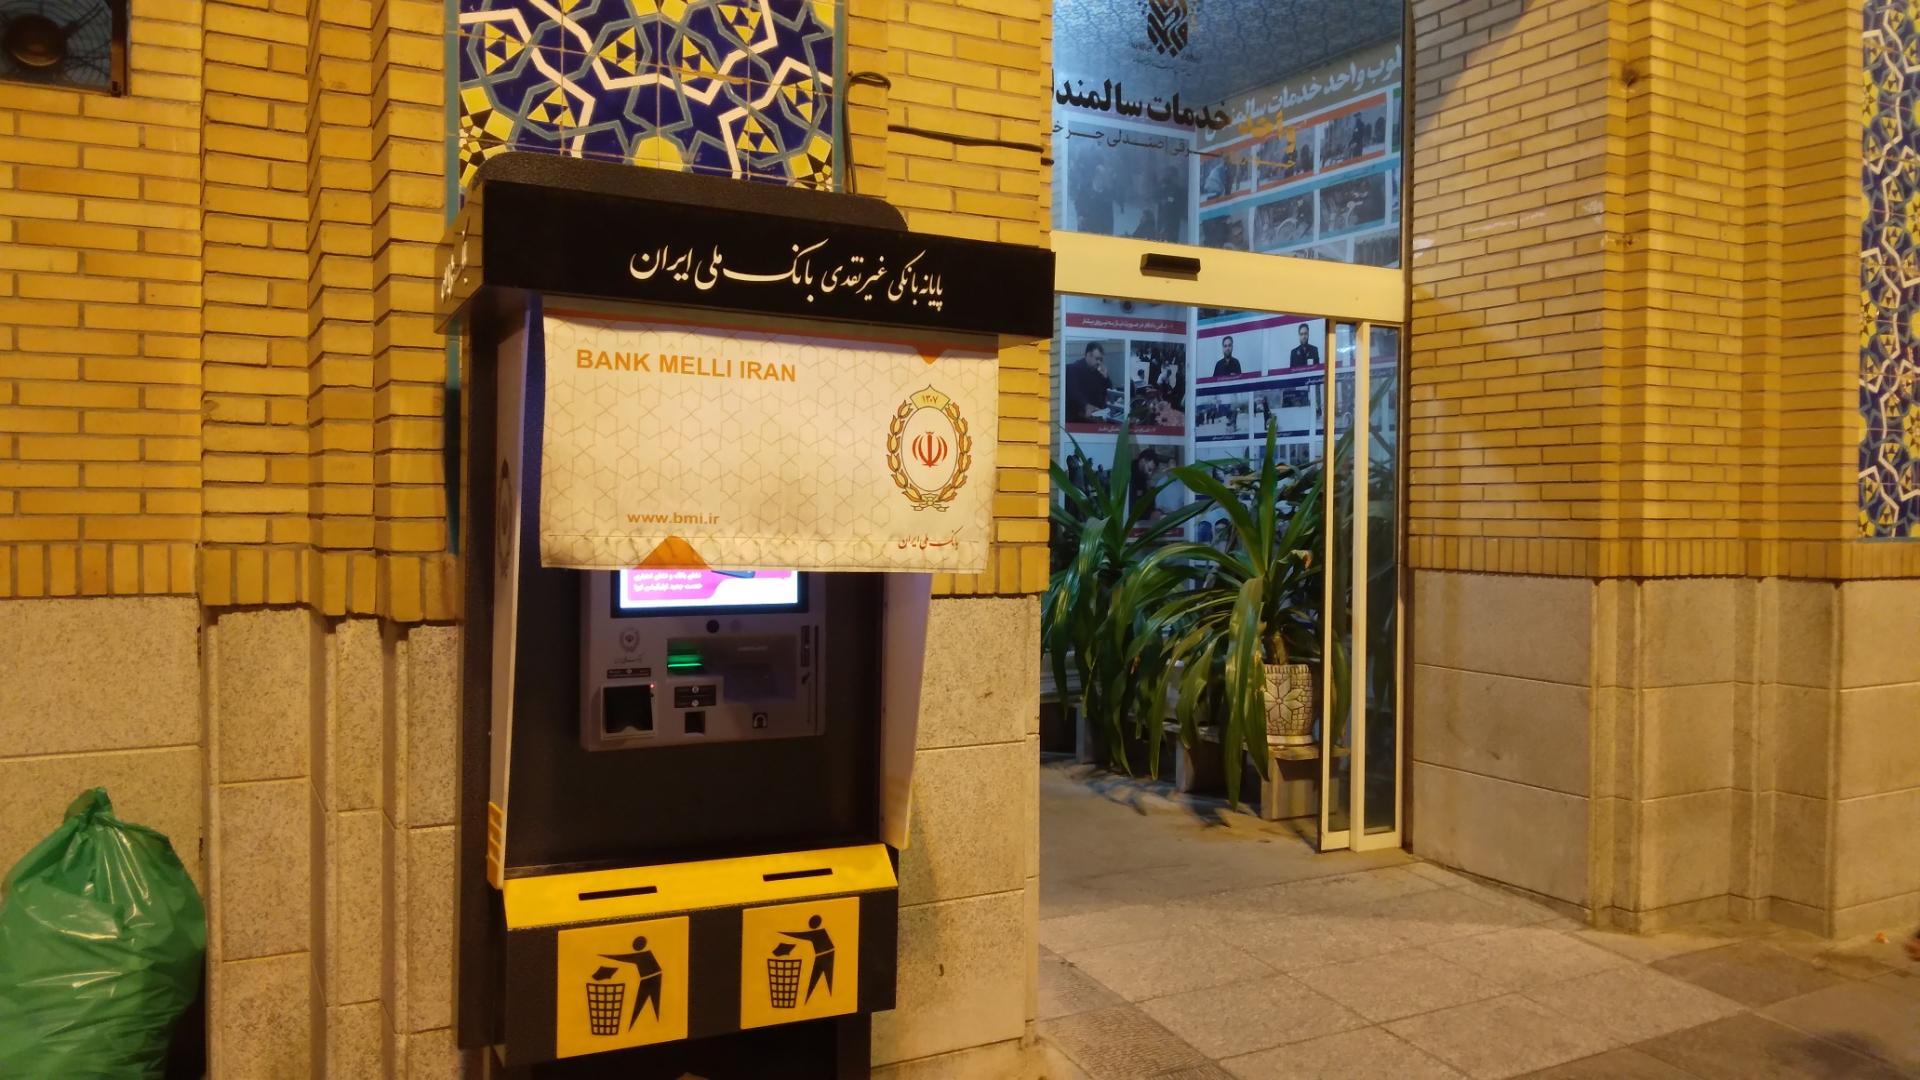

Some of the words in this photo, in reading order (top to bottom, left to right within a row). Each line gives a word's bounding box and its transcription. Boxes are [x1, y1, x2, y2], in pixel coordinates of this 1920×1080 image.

[1147, 91, 1232, 130] خدمات
[1268, 76, 1322, 113] خدمات
[630, 245, 693, 281] ایران
[694, 245, 723, 290] ملی
[722, 238, 829, 302] بانک
[820, 255, 864, 292] نقدی
[855, 255, 888, 301] غیر
[887, 250, 926, 301] بانکی
[919, 273, 944, 311] پایانه
[576, 349, 650, 372] BANK
[659, 354, 732, 382] MELLI
[740, 360, 796, 382] IRAN
[627, 512, 720, 524] www.bmi.ir
[897, 535, 919, 550] ایران
[919, 534, 929, 550] ملی
[926, 525, 963, 550] بانک
